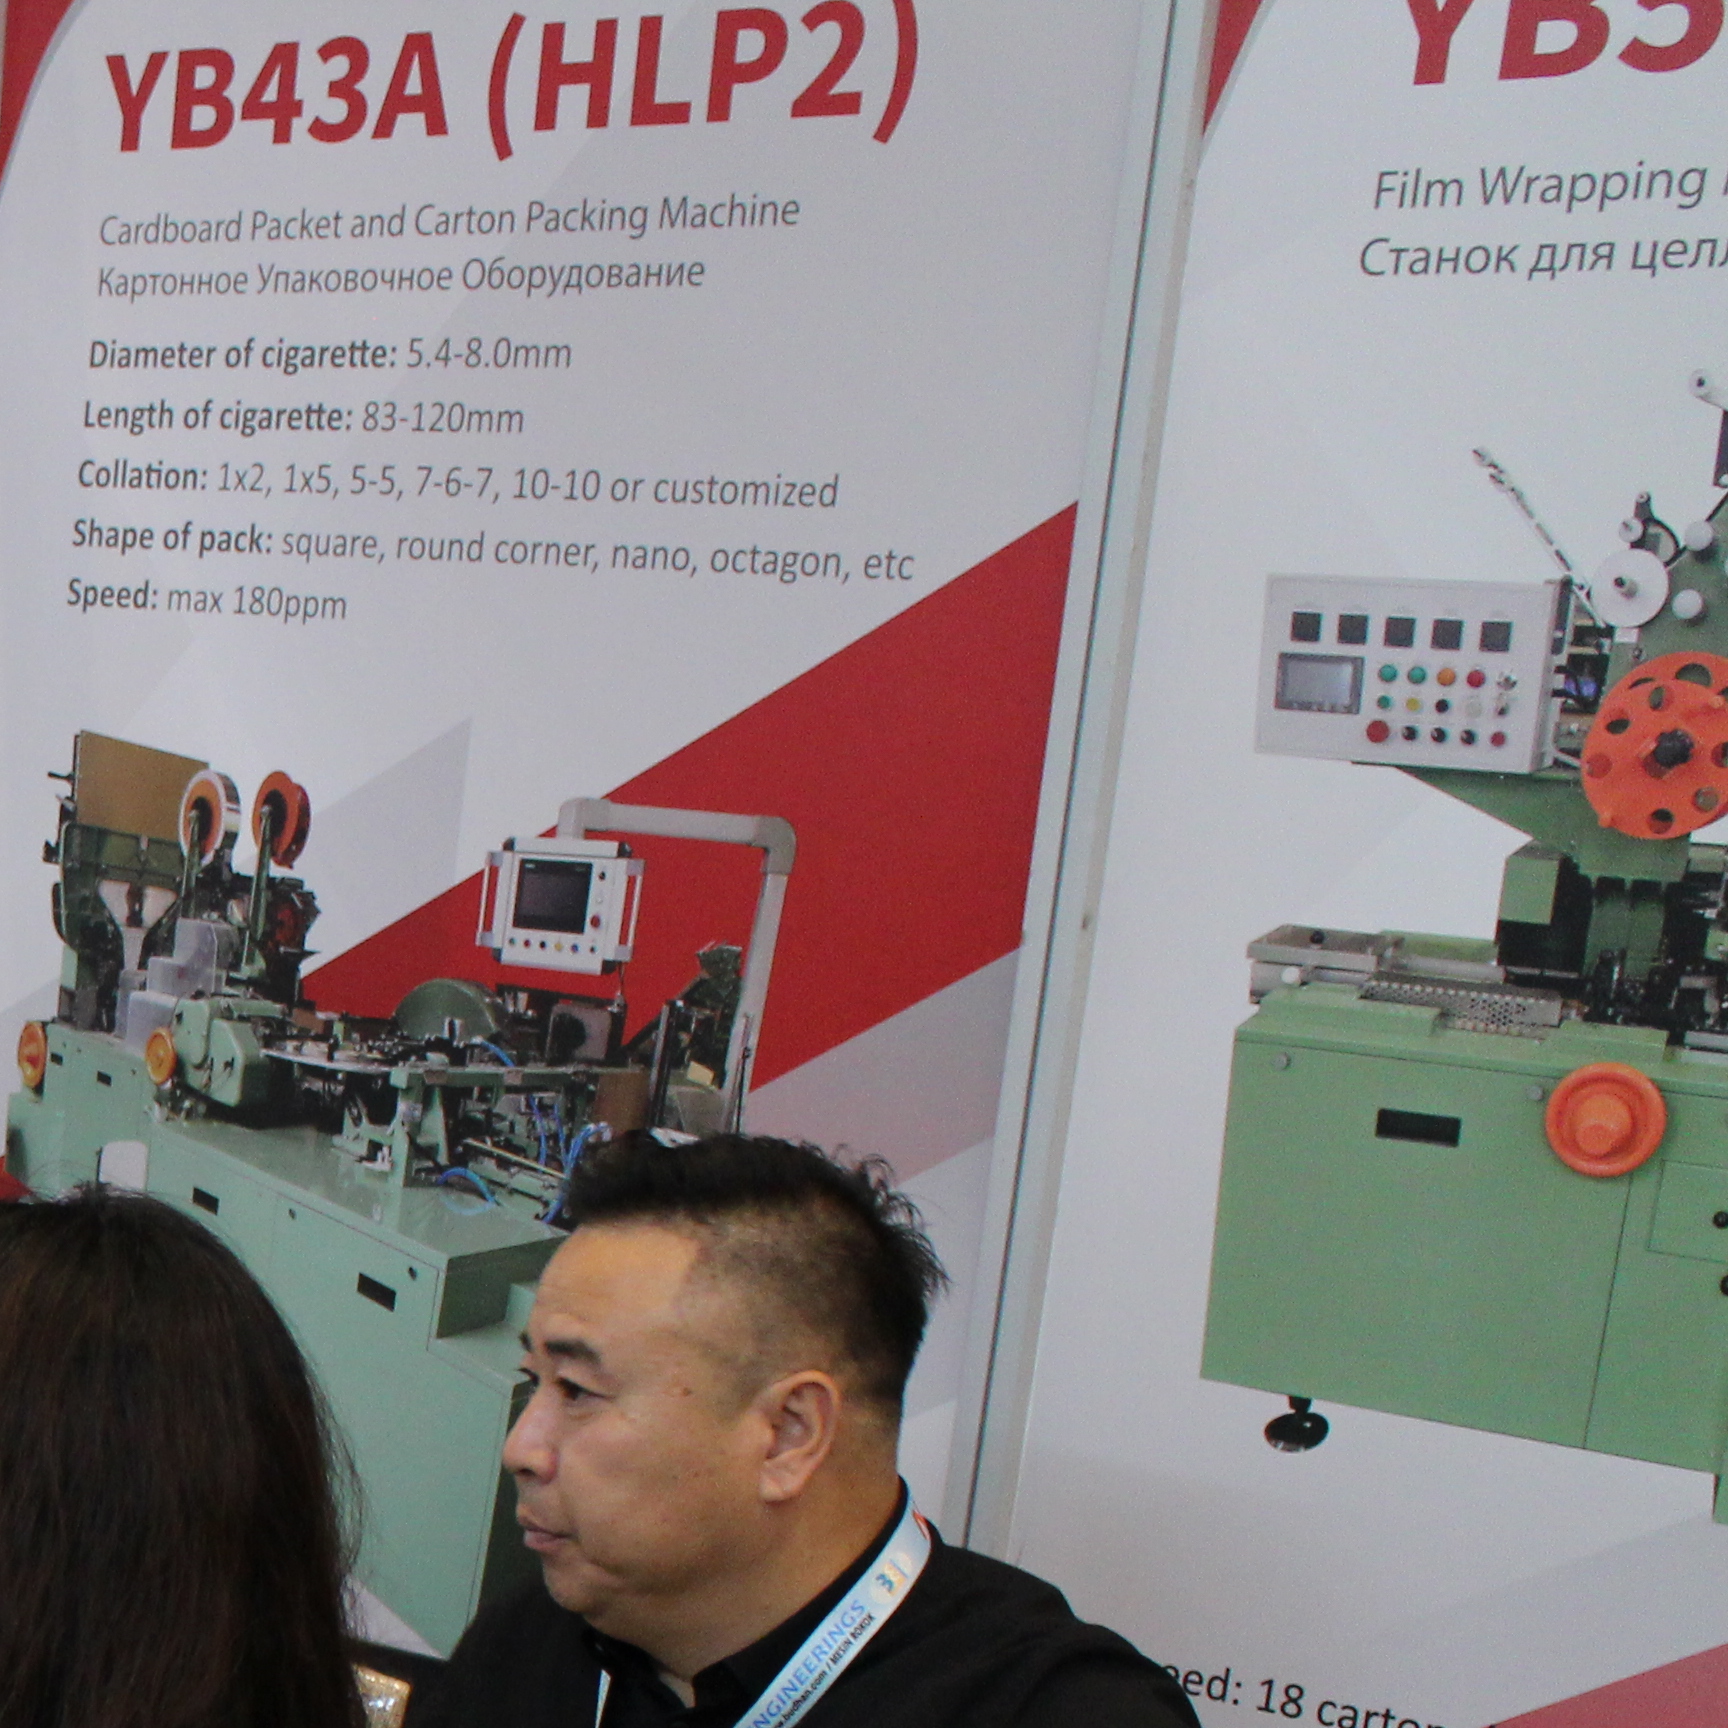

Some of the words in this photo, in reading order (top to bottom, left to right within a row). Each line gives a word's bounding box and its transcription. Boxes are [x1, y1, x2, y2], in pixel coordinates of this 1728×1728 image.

[106, 33, 448, 152] YB43A
[488, 0, 917, 161] (HLP2)
[1374, 167, 1463, 209] Film
[1480, 160, 1707, 214] Wrapping
[100, 210, 242, 246] Cardboard
[251, 208, 343, 241] Packet
[350, 204, 406, 238] and
[415, 204, 515, 236] Carton
[526, 198, 648, 240] Packing
[659, 193, 800, 229] Machine
[98, 267, 248, 303] Картонное
[257, 264, 453, 294] Упаковочное
[462, 256, 705, 298] Оборудование
[1359, 237, 1519, 277] Станок
[1528, 239, 1615, 282] для
[90, 340, 216, 368] Diameter
[225, 337, 255, 368] of
[262, 338, 396, 376] cigarette:
[407, 337, 571, 368] 5.4-8.0mm
[84, 399, 173, 436] Length
[183, 399, 213, 429] of
[220, 400, 352, 437] cigarette:
[362, 401, 524, 433] 83-120mm
[78, 459, 207, 490] Collation:
[218, 462, 271, 498] 1x2,
[284, 464, 339, 499] 1x5,
[350, 464, 403, 501] 5-5,
[417, 466, 499, 504] 7-6-7,
[513, 468, 600, 501] 10-10
[610, 478, 645, 502] or
[654, 474, 839, 508] customized
[73, 518, 154, 555] Shape
[163, 521, 192, 550] of
[199, 523, 272, 558] pack:
[282, 533, 385, 564] square,
[397, 531, 485, 562] round
[494, 540, 598, 573] corner,
[612, 545, 697, 577] nano,
[710, 545, 849, 584] octagon,
[864, 550, 914, 581] etc
[67, 578, 157, 613] Speed:
[168, 589, 223, 613] max
[234, 586, 346, 624] 180ppm
[1256, 1678, 1305, 1719] 18
